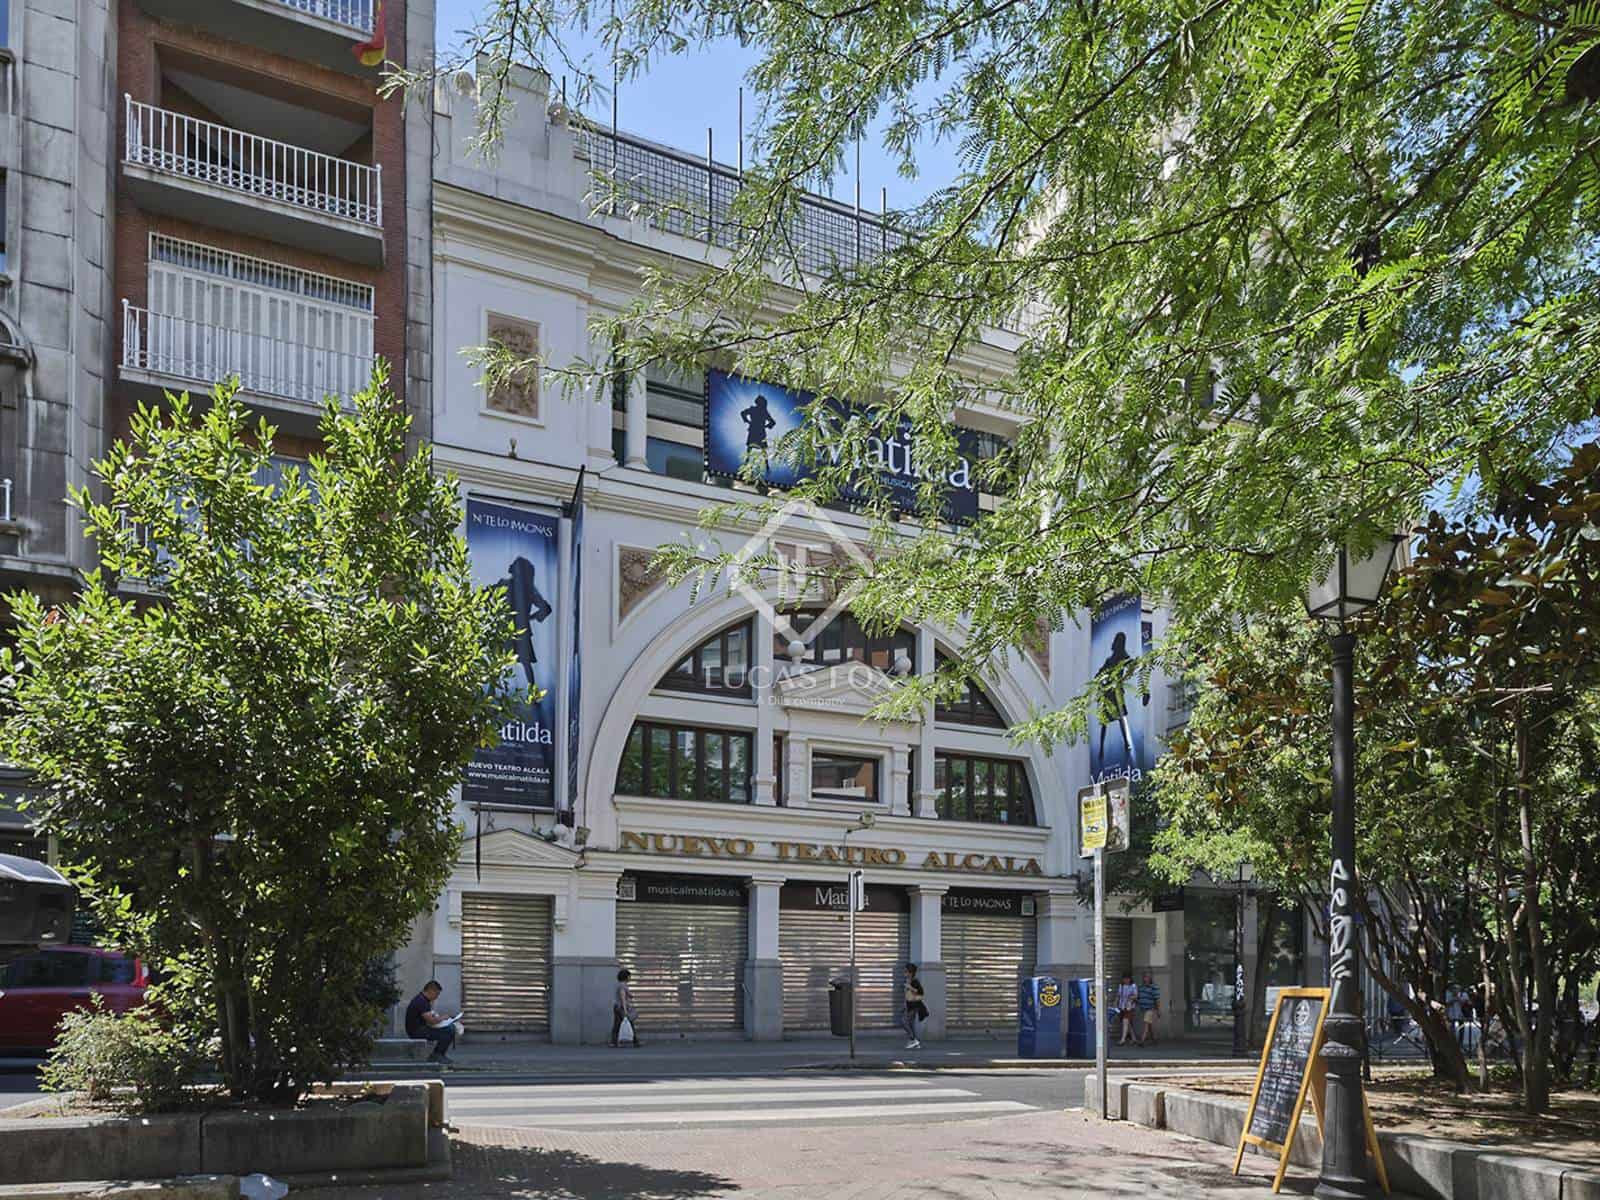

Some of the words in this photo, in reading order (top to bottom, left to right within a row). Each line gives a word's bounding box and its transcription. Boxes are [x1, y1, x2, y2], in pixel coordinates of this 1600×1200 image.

[815, 414, 971, 489] Matia
[497, 720, 552, 744] atilda
[468, 761, 492, 770] NUEVO
[494, 763, 521, 772] TEATRO
[620, 832, 755, 857] NUEVO
[772, 841, 907, 866] TEATRO
[647, 885, 741, 897] musicalmatilda.es
[816, 887, 870, 906] Matia
